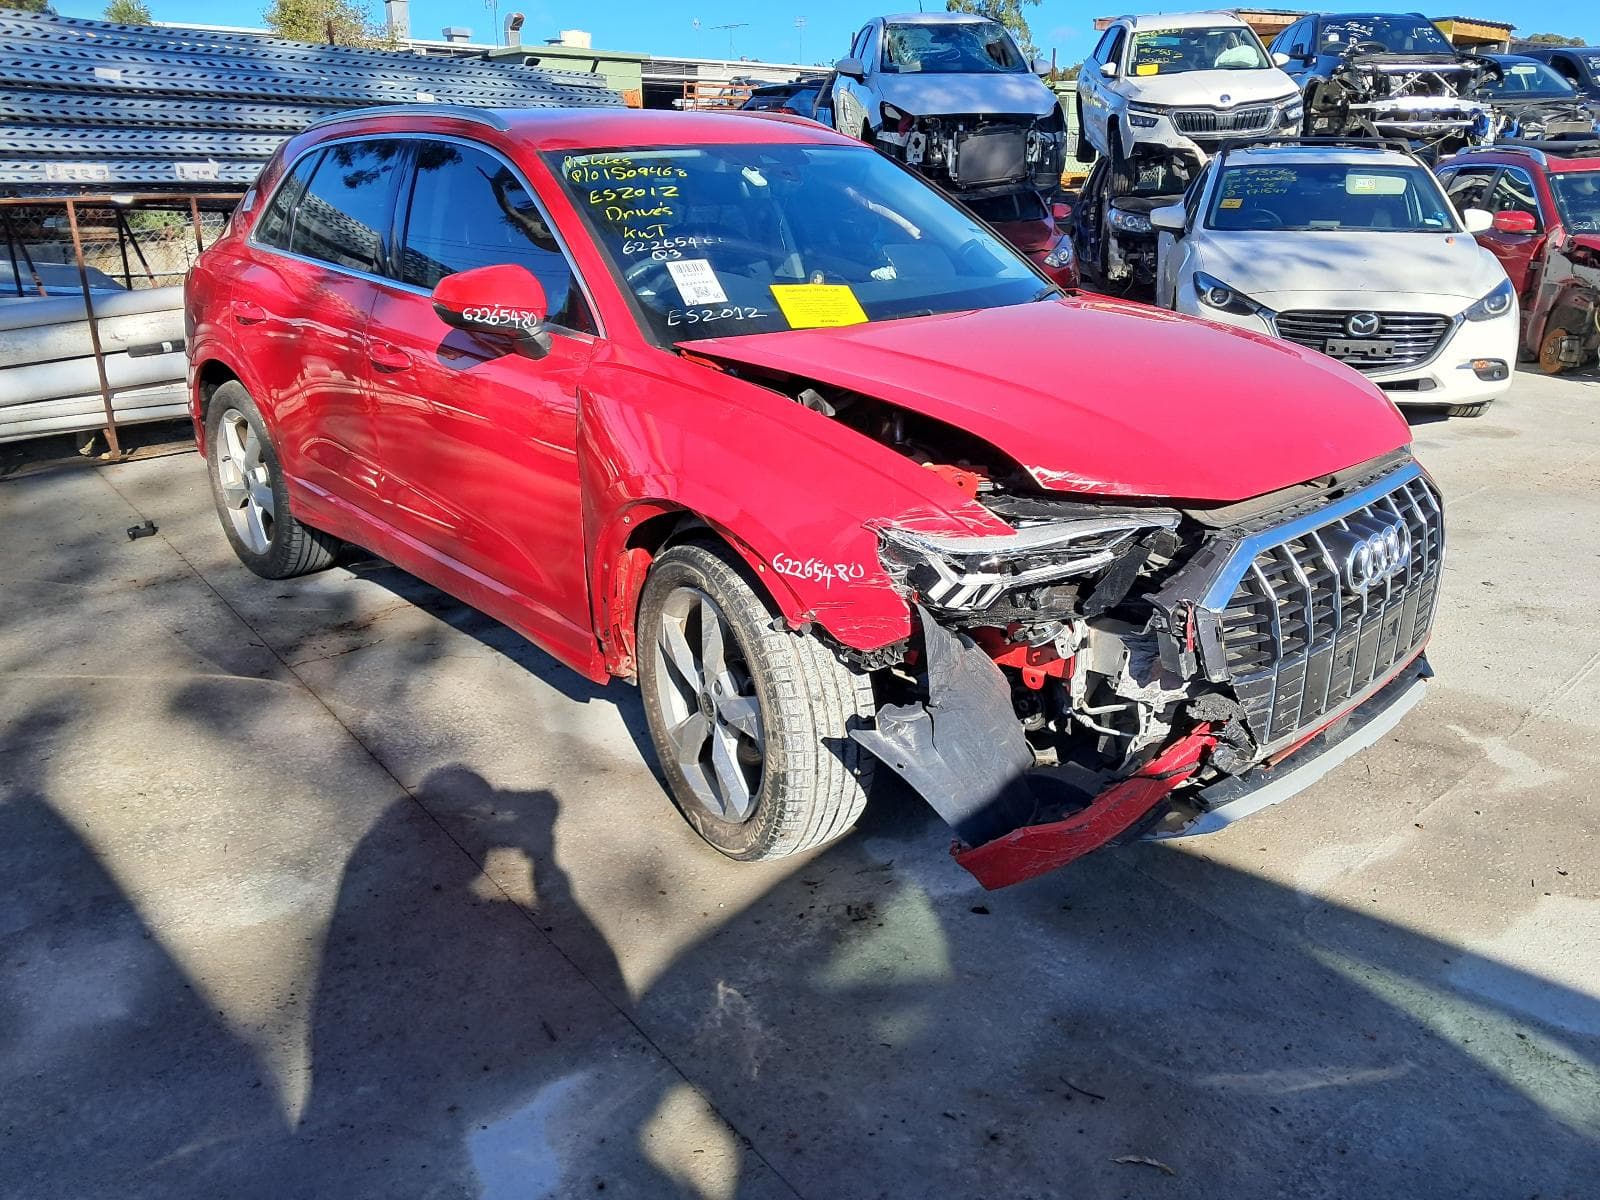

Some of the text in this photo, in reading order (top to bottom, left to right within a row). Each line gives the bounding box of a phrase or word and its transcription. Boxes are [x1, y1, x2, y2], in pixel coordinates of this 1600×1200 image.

[651, 249, 682, 261] Q3
[462, 305, 537, 329] 62265480
[666, 307, 768, 326] ES2012
